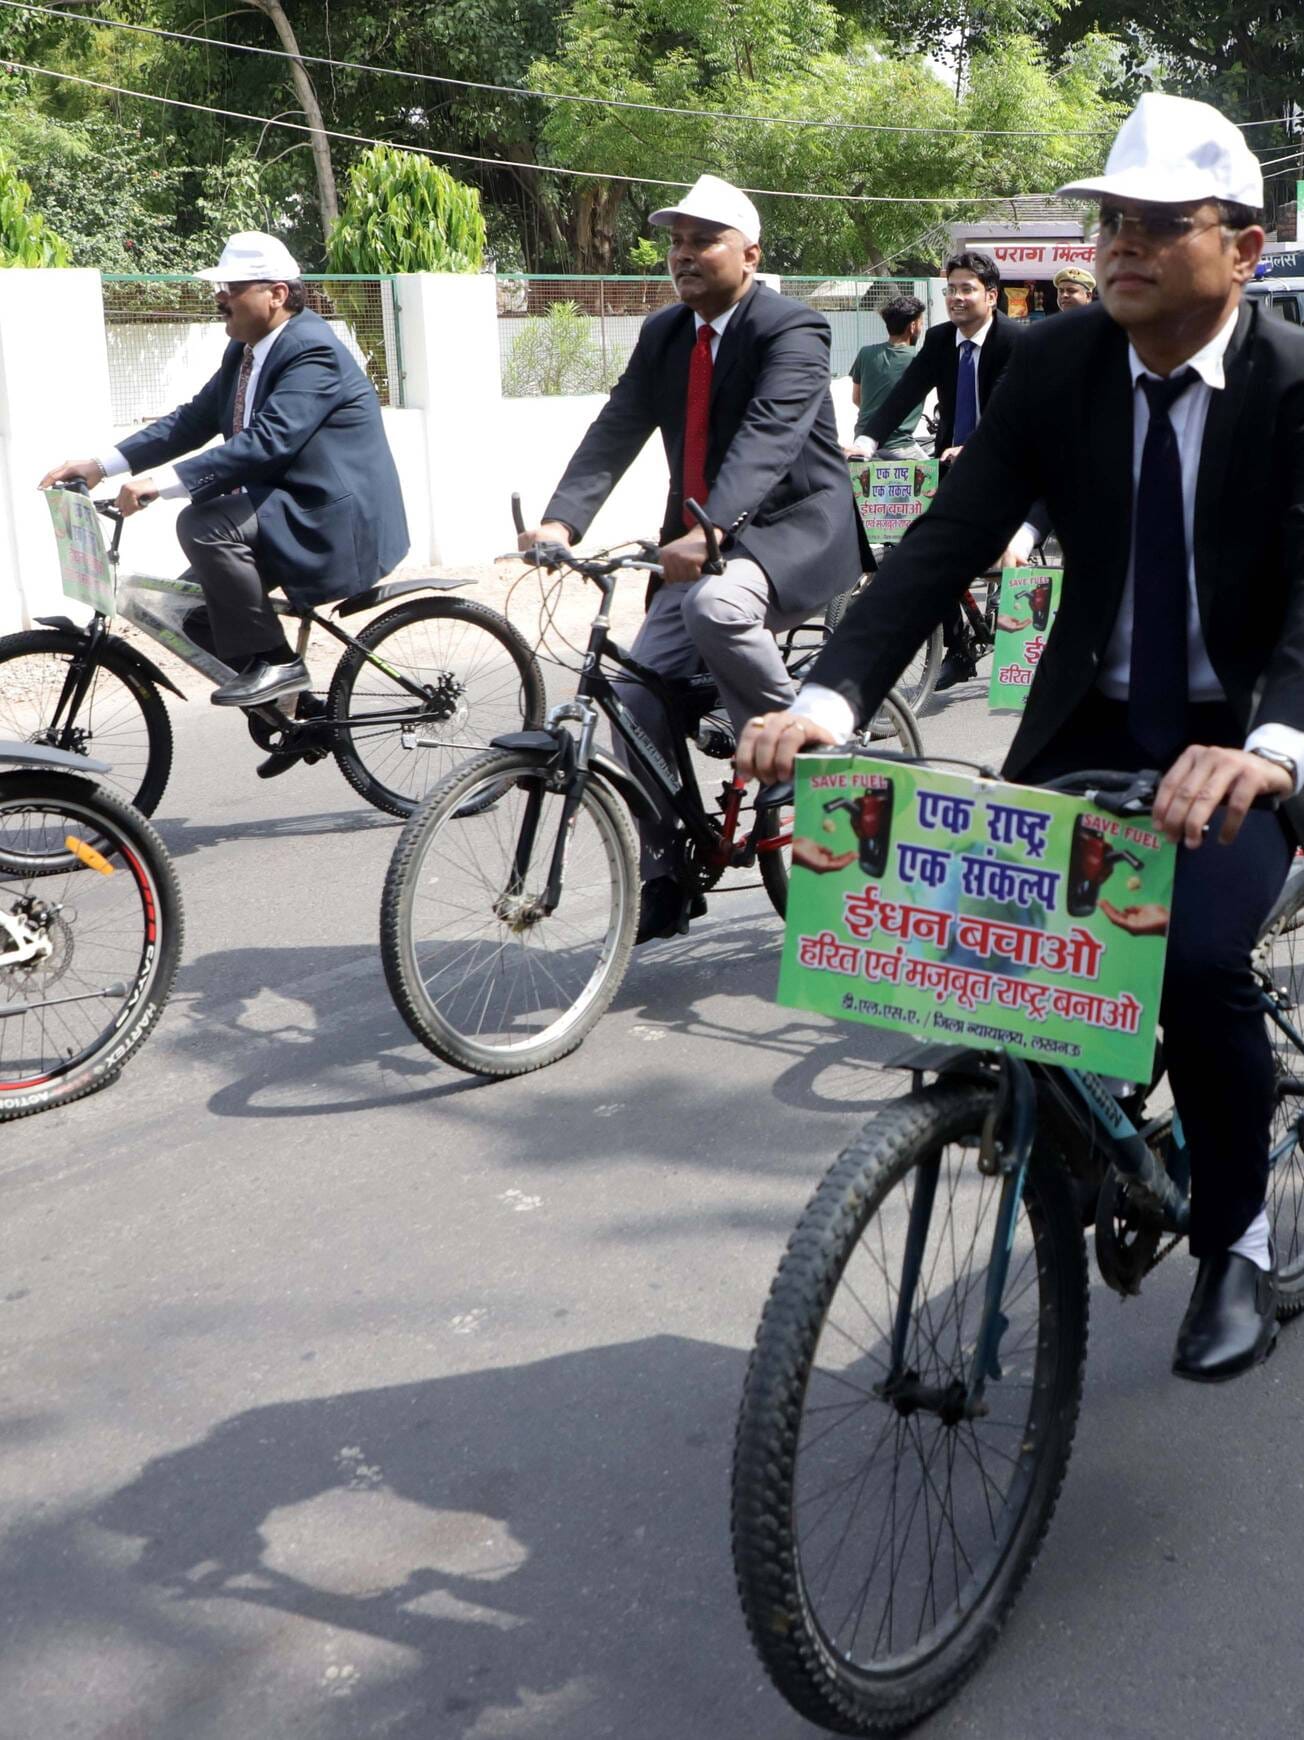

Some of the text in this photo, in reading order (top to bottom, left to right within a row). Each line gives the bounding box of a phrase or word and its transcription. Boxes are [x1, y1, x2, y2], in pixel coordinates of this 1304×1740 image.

[994, 247, 1046, 262] पराग
[1009, 577, 1027, 587] SAVE
[1000, 665, 1033, 685] हरित
[811, 775, 888, 790] SAVE FUEL
[917, 790, 1051, 856] एक राष्ट्र
[1082, 813, 1162, 850] SAVE FUEL
[897, 844, 1060, 910] एक संकल्प
[845, 886, 1104, 978] ईधन बचाओ
[800, 932, 1142, 1034] हरित एवं मज़बूत राष्ट्र बनाओ
[105, 1002, 157, 1068] HARTEX
[933, 1010, 964, 1035] जिला
